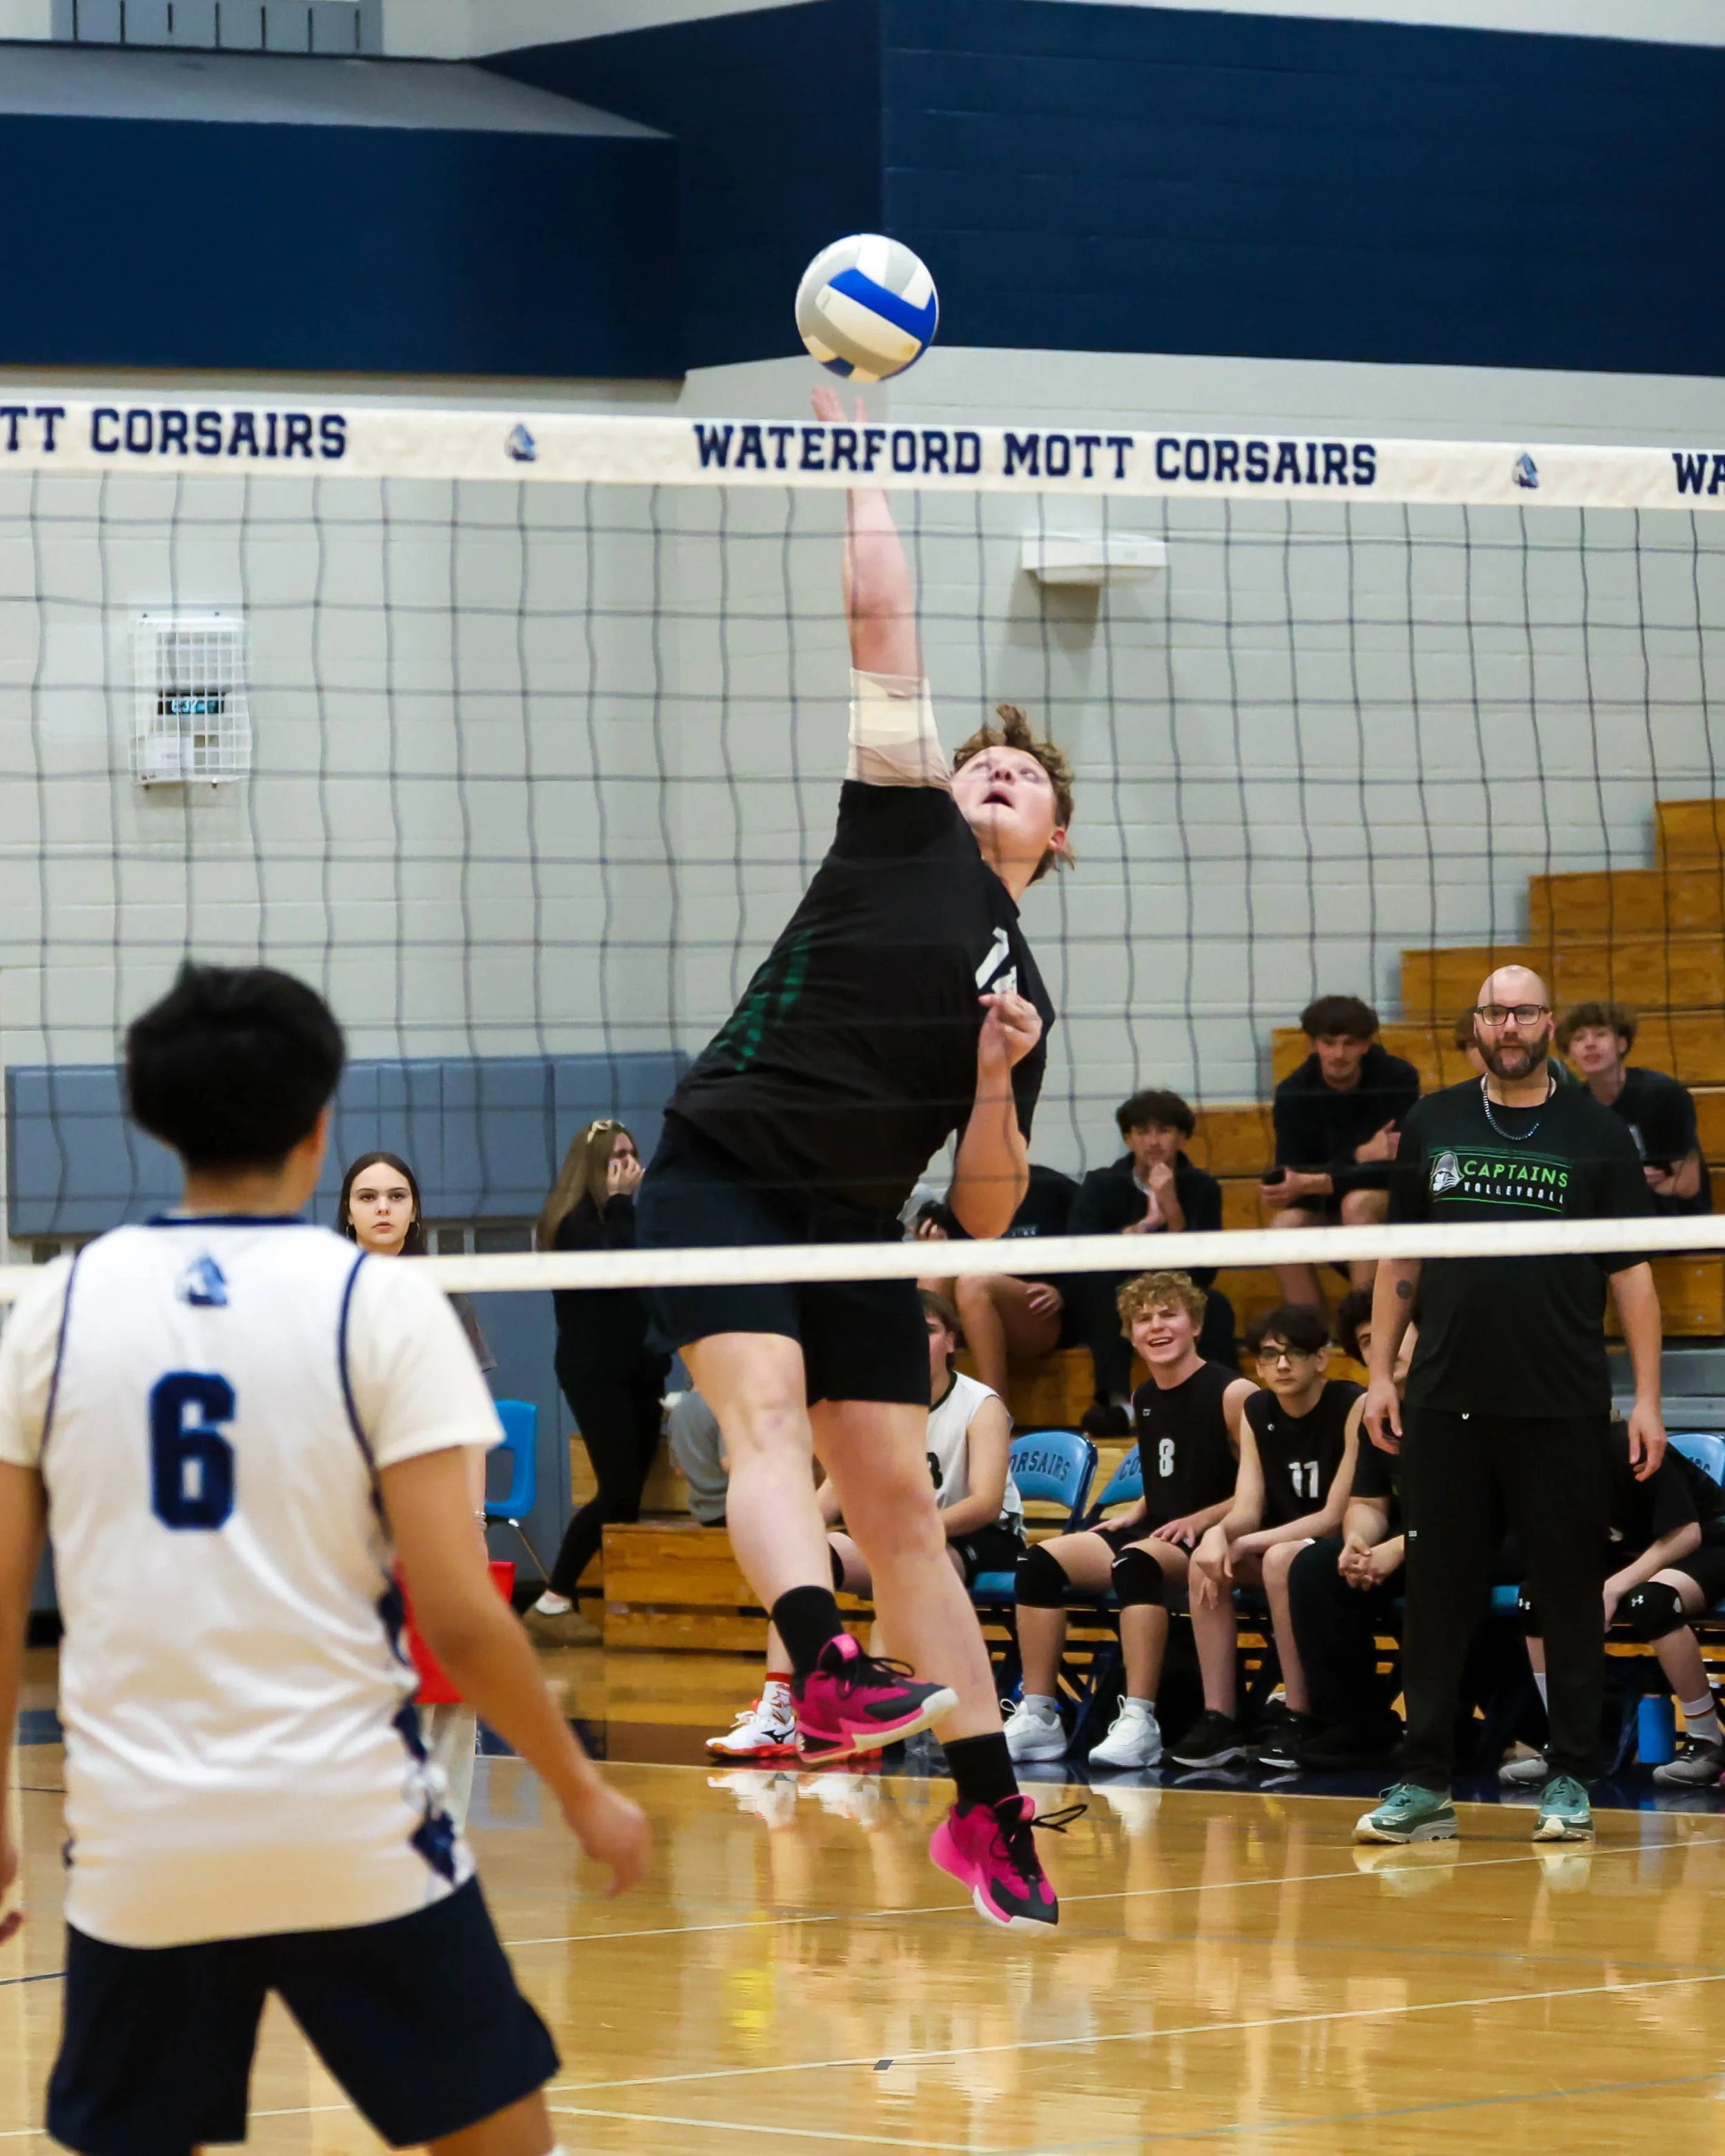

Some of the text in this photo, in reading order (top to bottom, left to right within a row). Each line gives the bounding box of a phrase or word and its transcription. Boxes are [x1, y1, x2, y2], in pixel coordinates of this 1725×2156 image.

[0, 406, 346, 459] TT CORSAIRS
[693, 424, 1376, 486] WATERFORD MOTT CORSAIRS
[1463, 1160, 1568, 1188] CAPTAINS
[149, 1371, 236, 1532] 6
[1159, 1438, 1175, 1477] 8
[1288, 1461, 1319, 1498] 11
